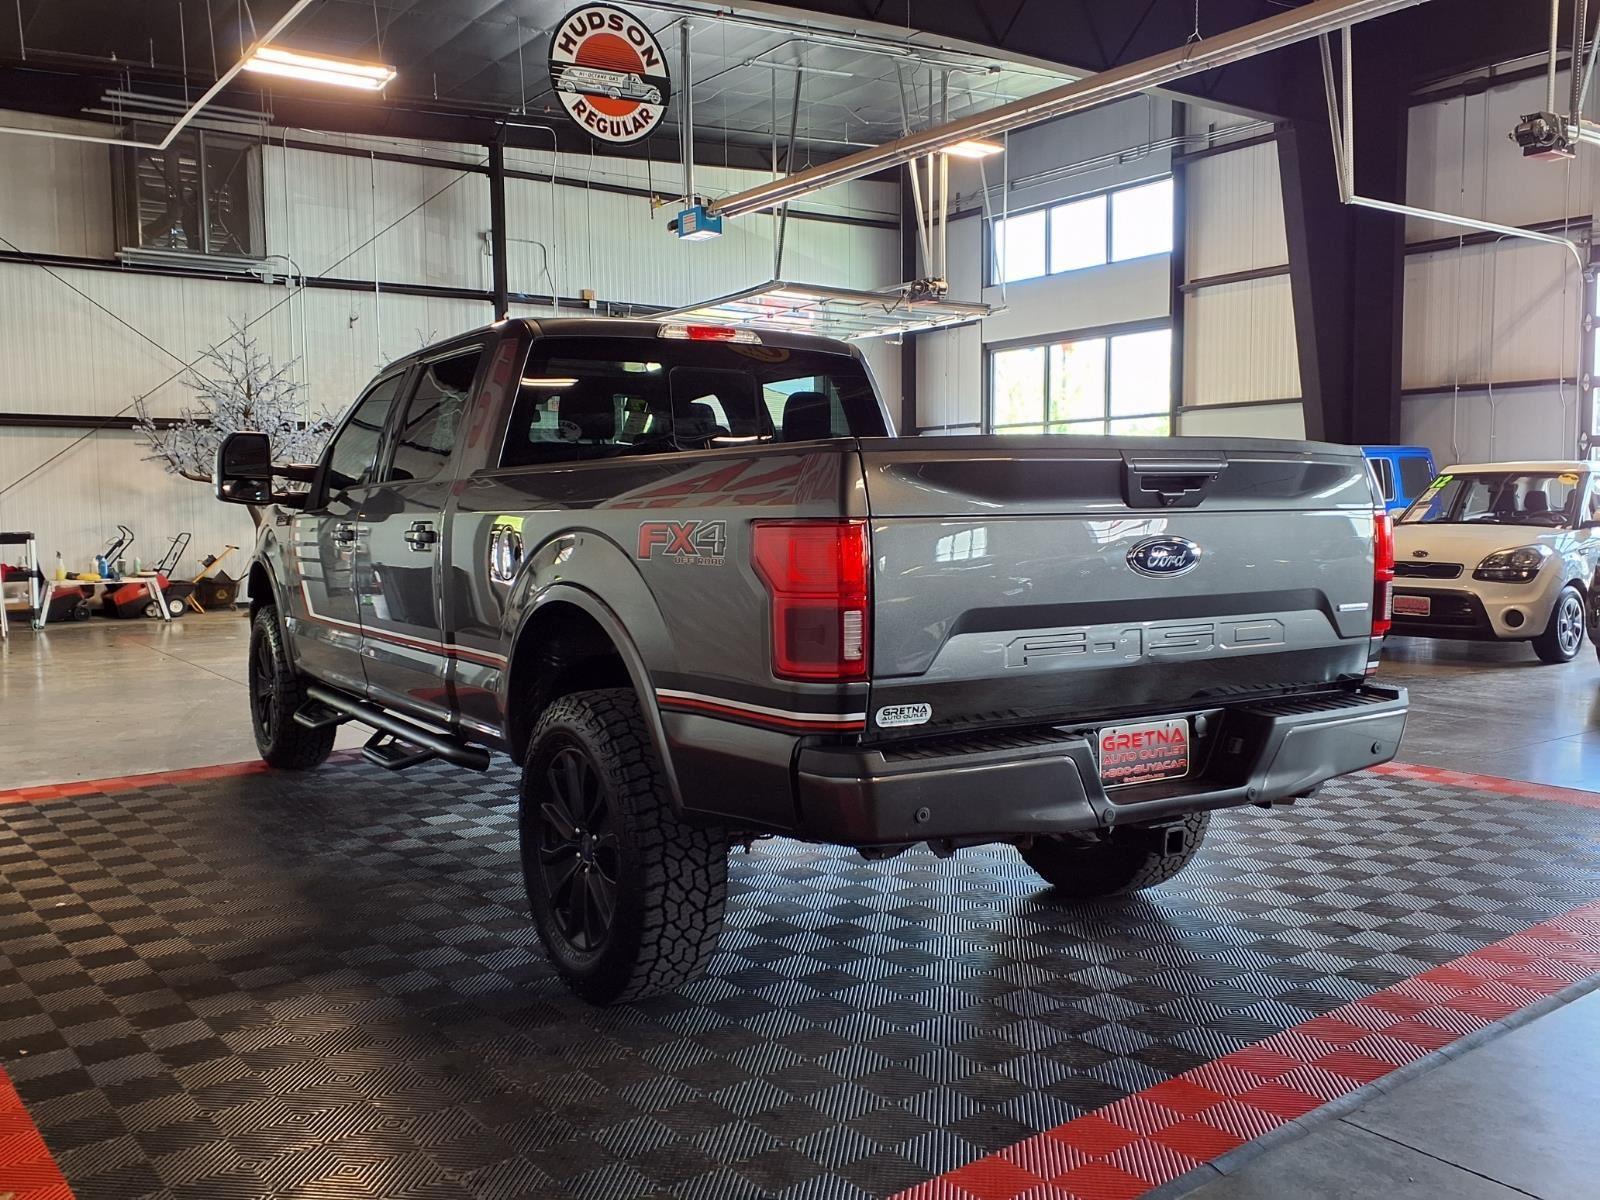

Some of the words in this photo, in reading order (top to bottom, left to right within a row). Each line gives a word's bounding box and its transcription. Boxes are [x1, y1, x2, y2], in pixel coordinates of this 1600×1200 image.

[558, 11, 660, 68] HUDSON
[571, 99, 654, 137] REGULAR
[636, 519, 727, 561] FX4
[673, 556, 695, 565] OFF
[697, 557, 725, 566] ROAD
[1147, 545, 1187, 568] Ford
[1004, 618, 1286, 669] F-150
[882, 705, 928, 716] GRETNA
[902, 712, 928, 720] OUTLET
[1102, 727, 1185, 752] GRETNA
[1102, 751, 1137, 766] AUTO
[1139, 744, 1187, 760] OUTLET
